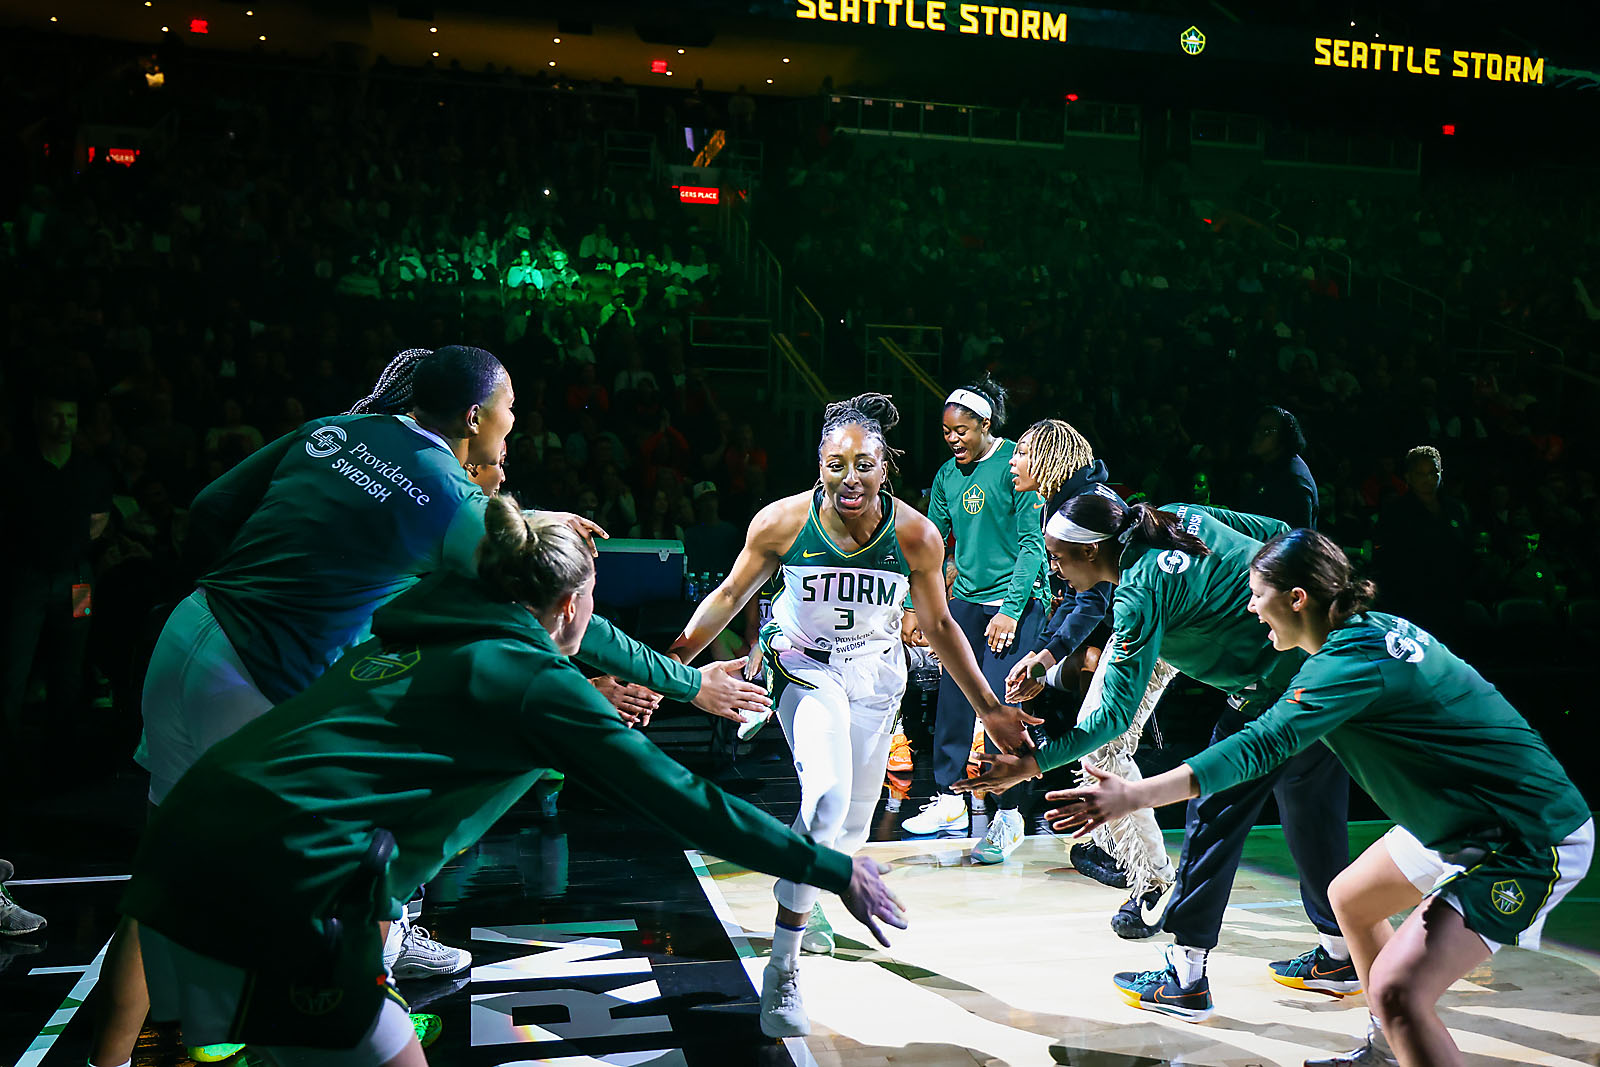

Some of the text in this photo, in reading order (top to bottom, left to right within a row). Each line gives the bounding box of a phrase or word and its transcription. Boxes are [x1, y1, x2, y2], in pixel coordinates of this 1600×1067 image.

[796, 0, 1067, 42] SEATTLE STORM
[1314, 37, 1545, 84] SEATTLE STORM
[331, 458, 393, 503] SWEDISH
[348, 442, 431, 506] Providence
[1186, 513, 1204, 536] EDISH
[802, 572, 898, 607] STORM
[834, 607, 854, 631] 3
[835, 640, 866, 653] SWEDISH
